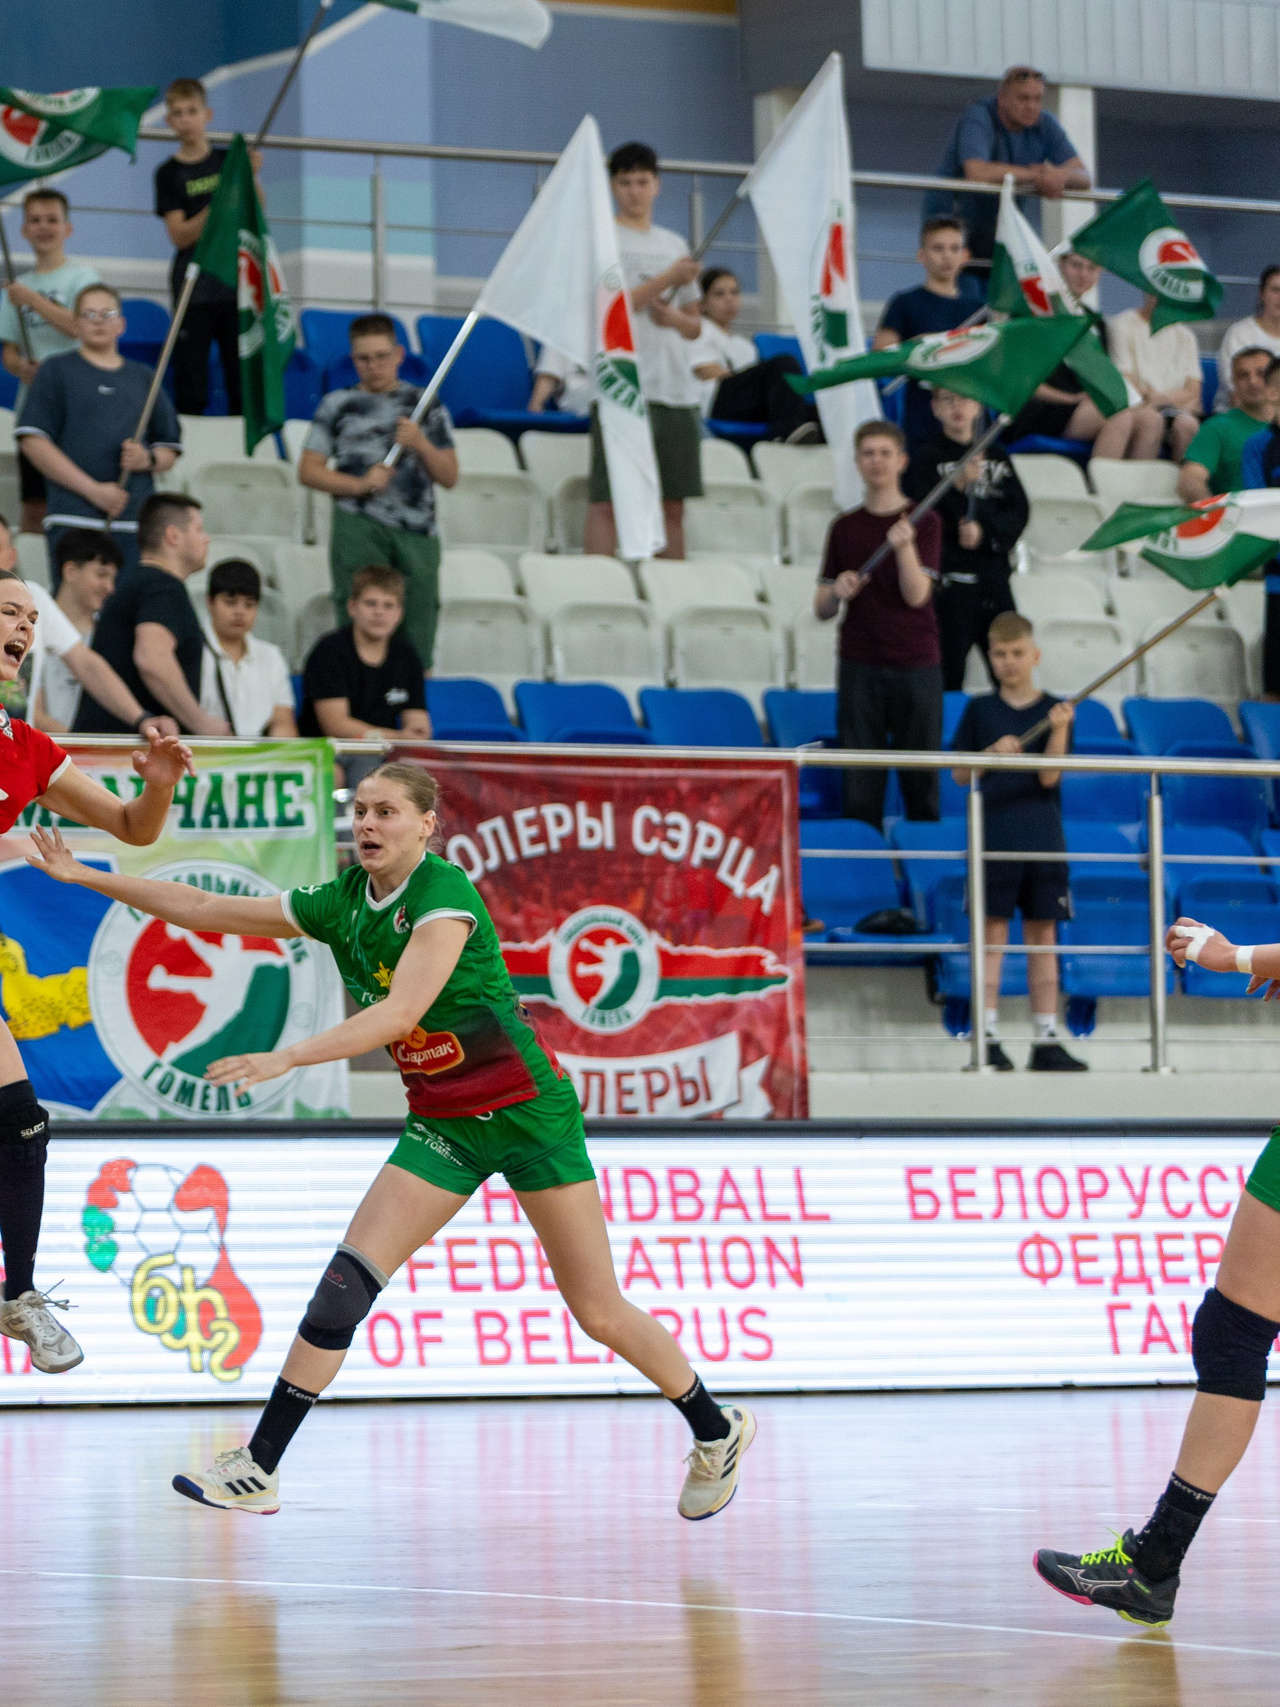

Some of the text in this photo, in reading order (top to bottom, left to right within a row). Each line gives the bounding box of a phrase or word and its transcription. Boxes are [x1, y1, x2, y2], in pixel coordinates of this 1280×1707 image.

[445, 800, 782, 916] ОЛЕРЫ СЭРЦА
[141, 1057, 253, 1113] ГОМЕЛЬ
[560, 1055, 713, 1116] ЛЕРЫ
[481, 1166, 831, 1224] HDBALL
[904, 1164, 1247, 1221] БЕЛОРУСС
[406, 1235, 805, 1292] FEDEATION
[367, 1305, 774, 1367] OF BELRUS
